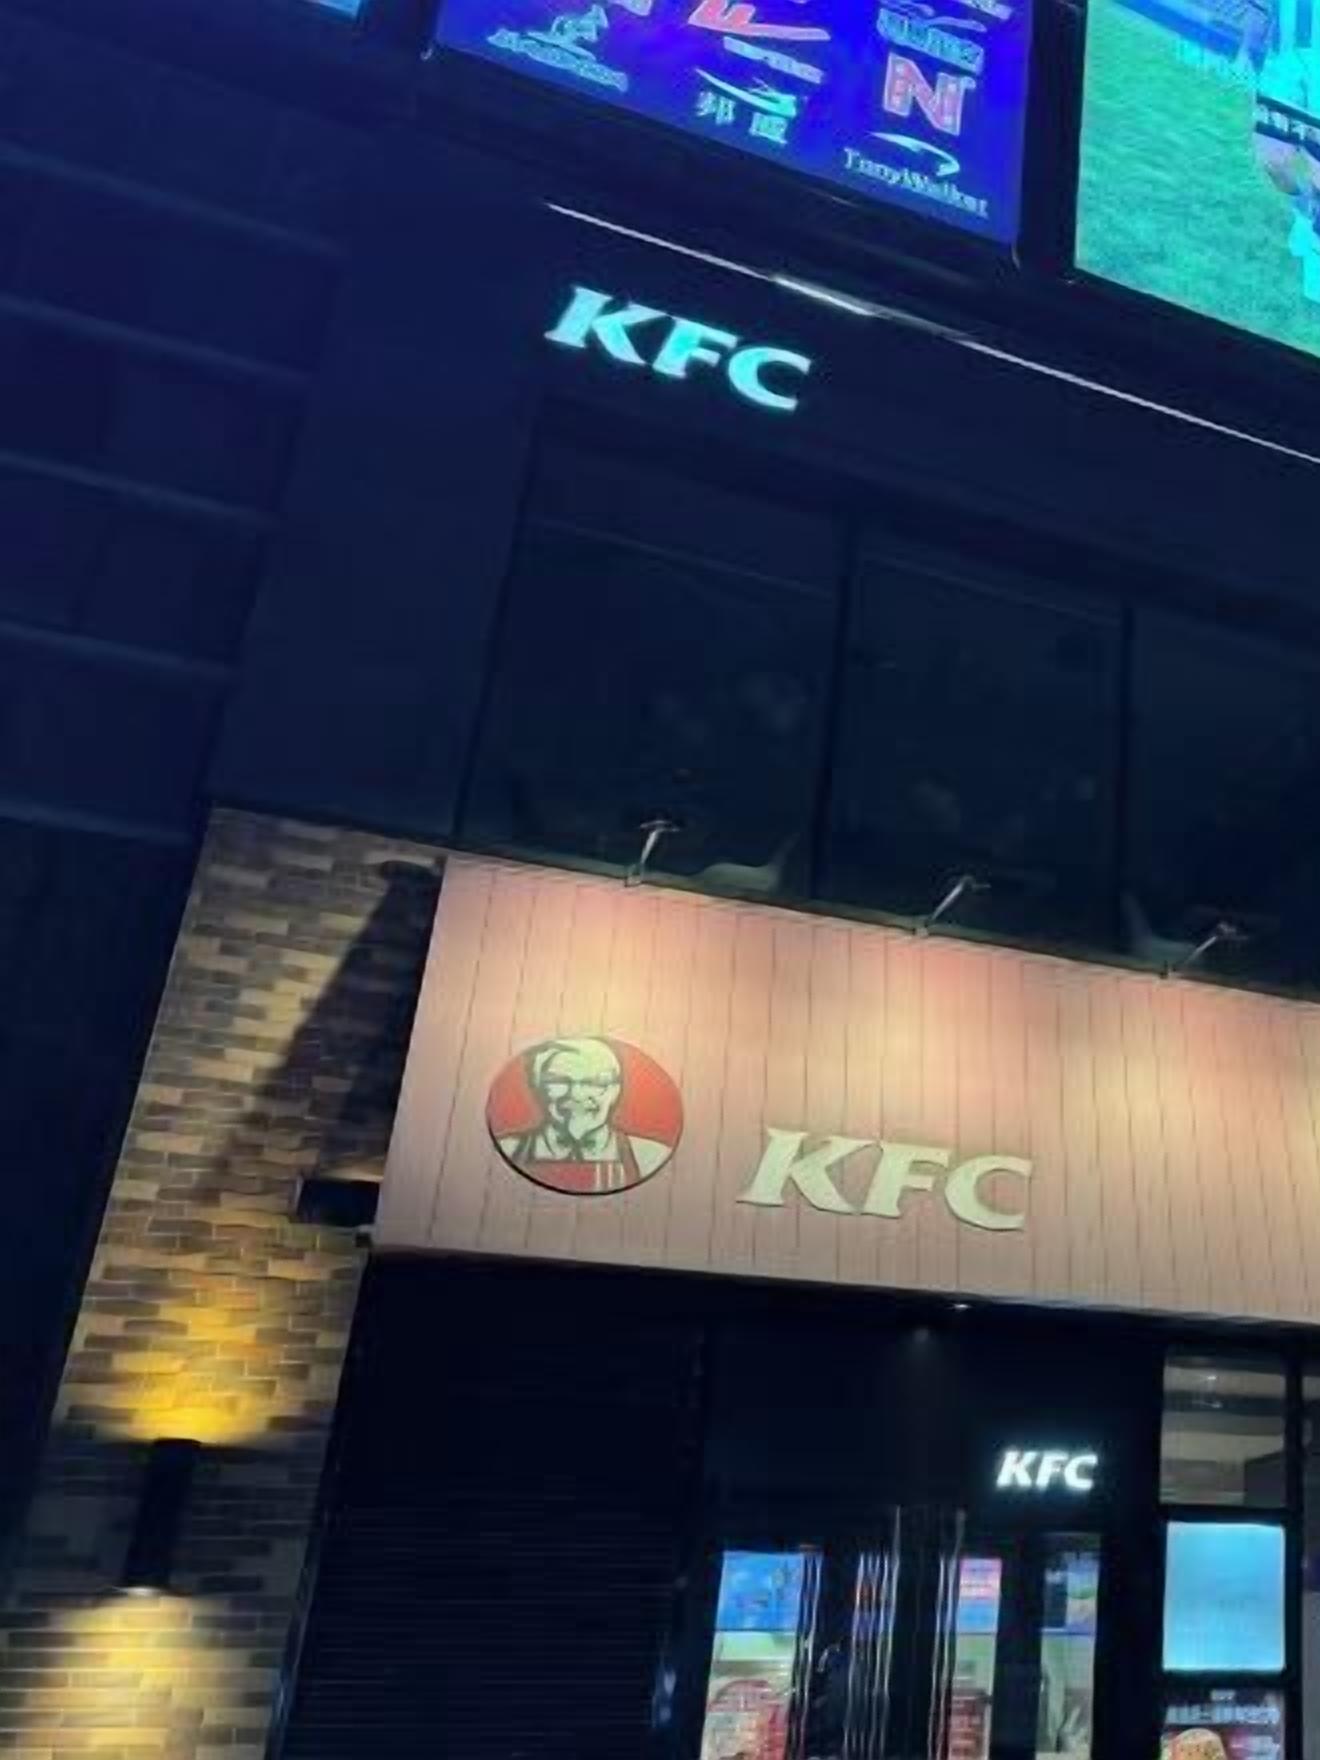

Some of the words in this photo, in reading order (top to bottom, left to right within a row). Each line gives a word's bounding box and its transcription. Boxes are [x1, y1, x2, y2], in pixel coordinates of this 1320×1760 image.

[545, 284, 812, 411] KFC
[736, 1127, 1032, 1232] KFC
[997, 1450, 1098, 1490] KFC
